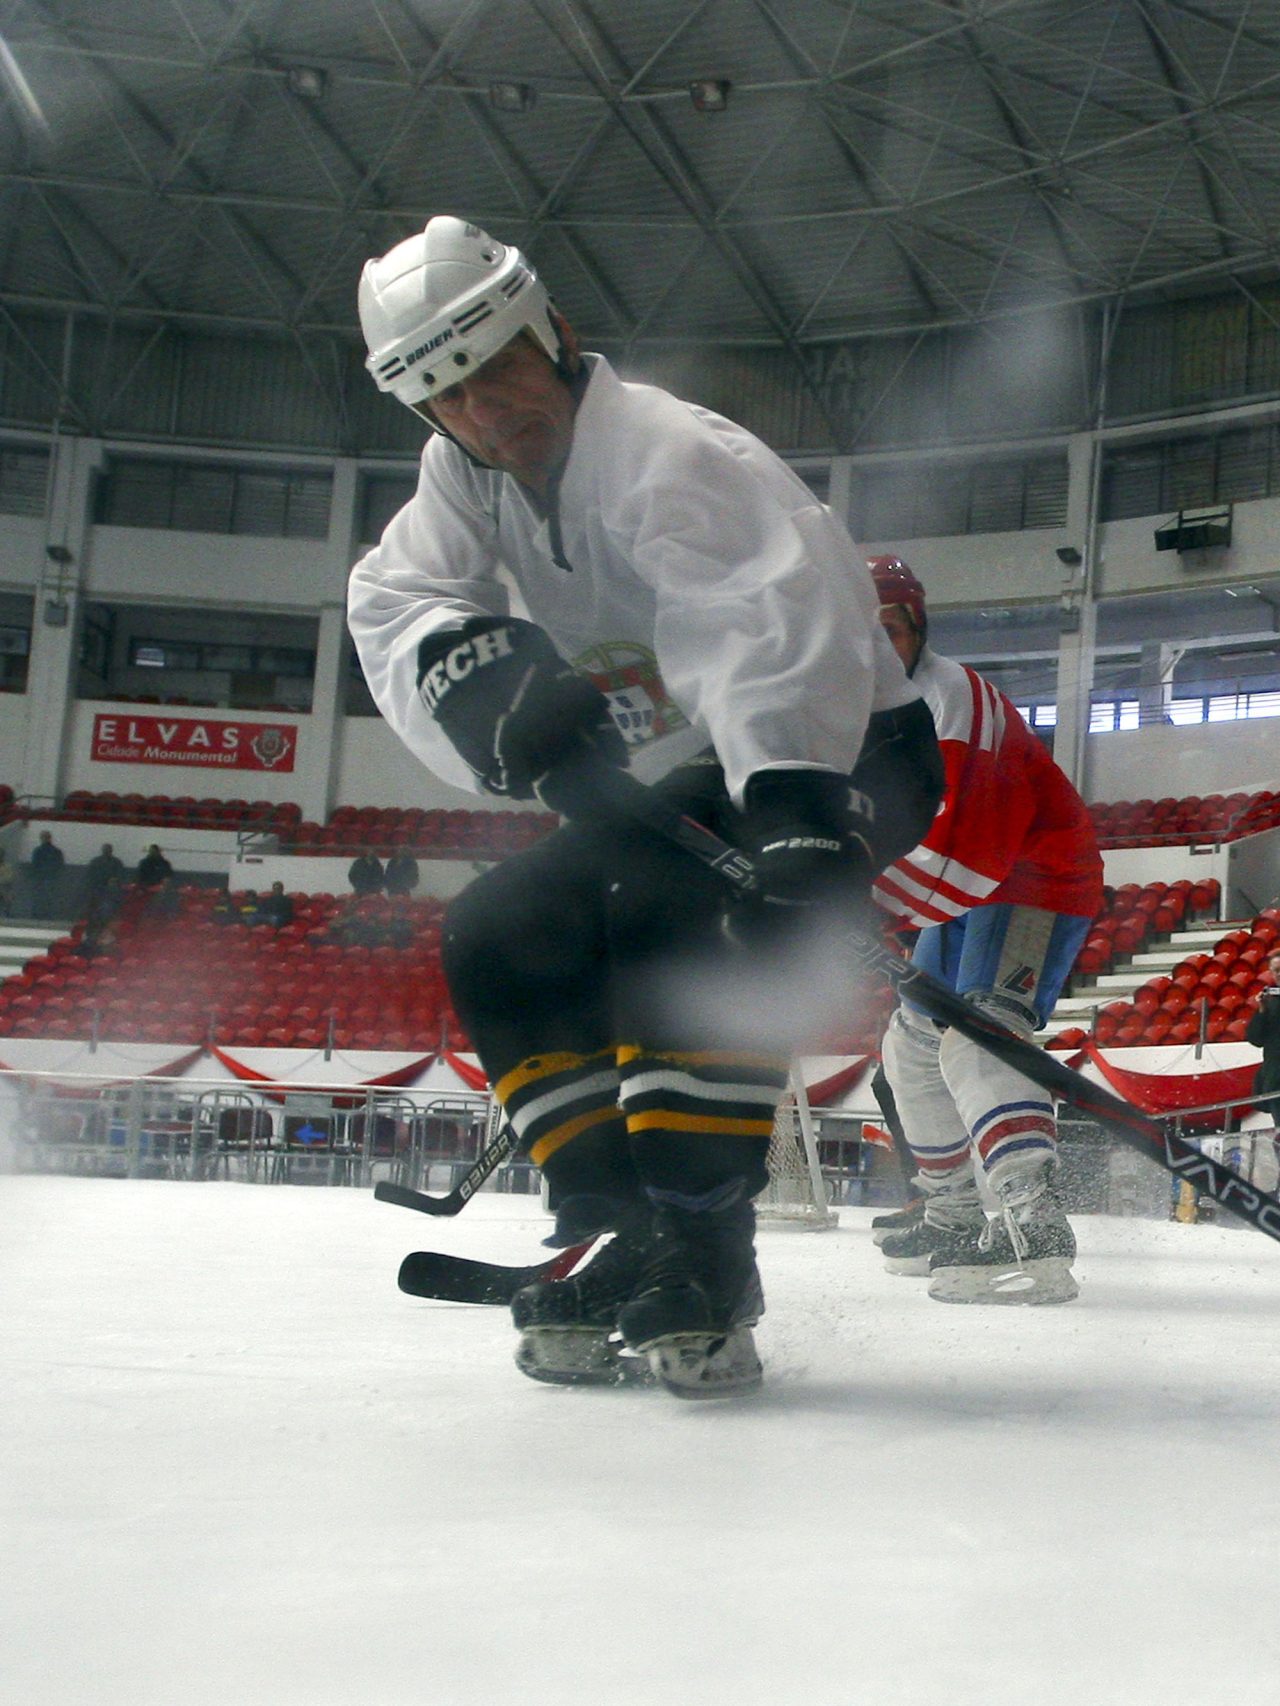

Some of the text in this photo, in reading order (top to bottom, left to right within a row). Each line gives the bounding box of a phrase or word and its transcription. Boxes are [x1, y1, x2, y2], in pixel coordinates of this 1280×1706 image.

[405, 328, 454, 367] BAUER
[99, 720, 240, 748] ELVAS
[98, 744, 237, 763] Cidade Monumental
[788, 837, 841, 851] 2200
